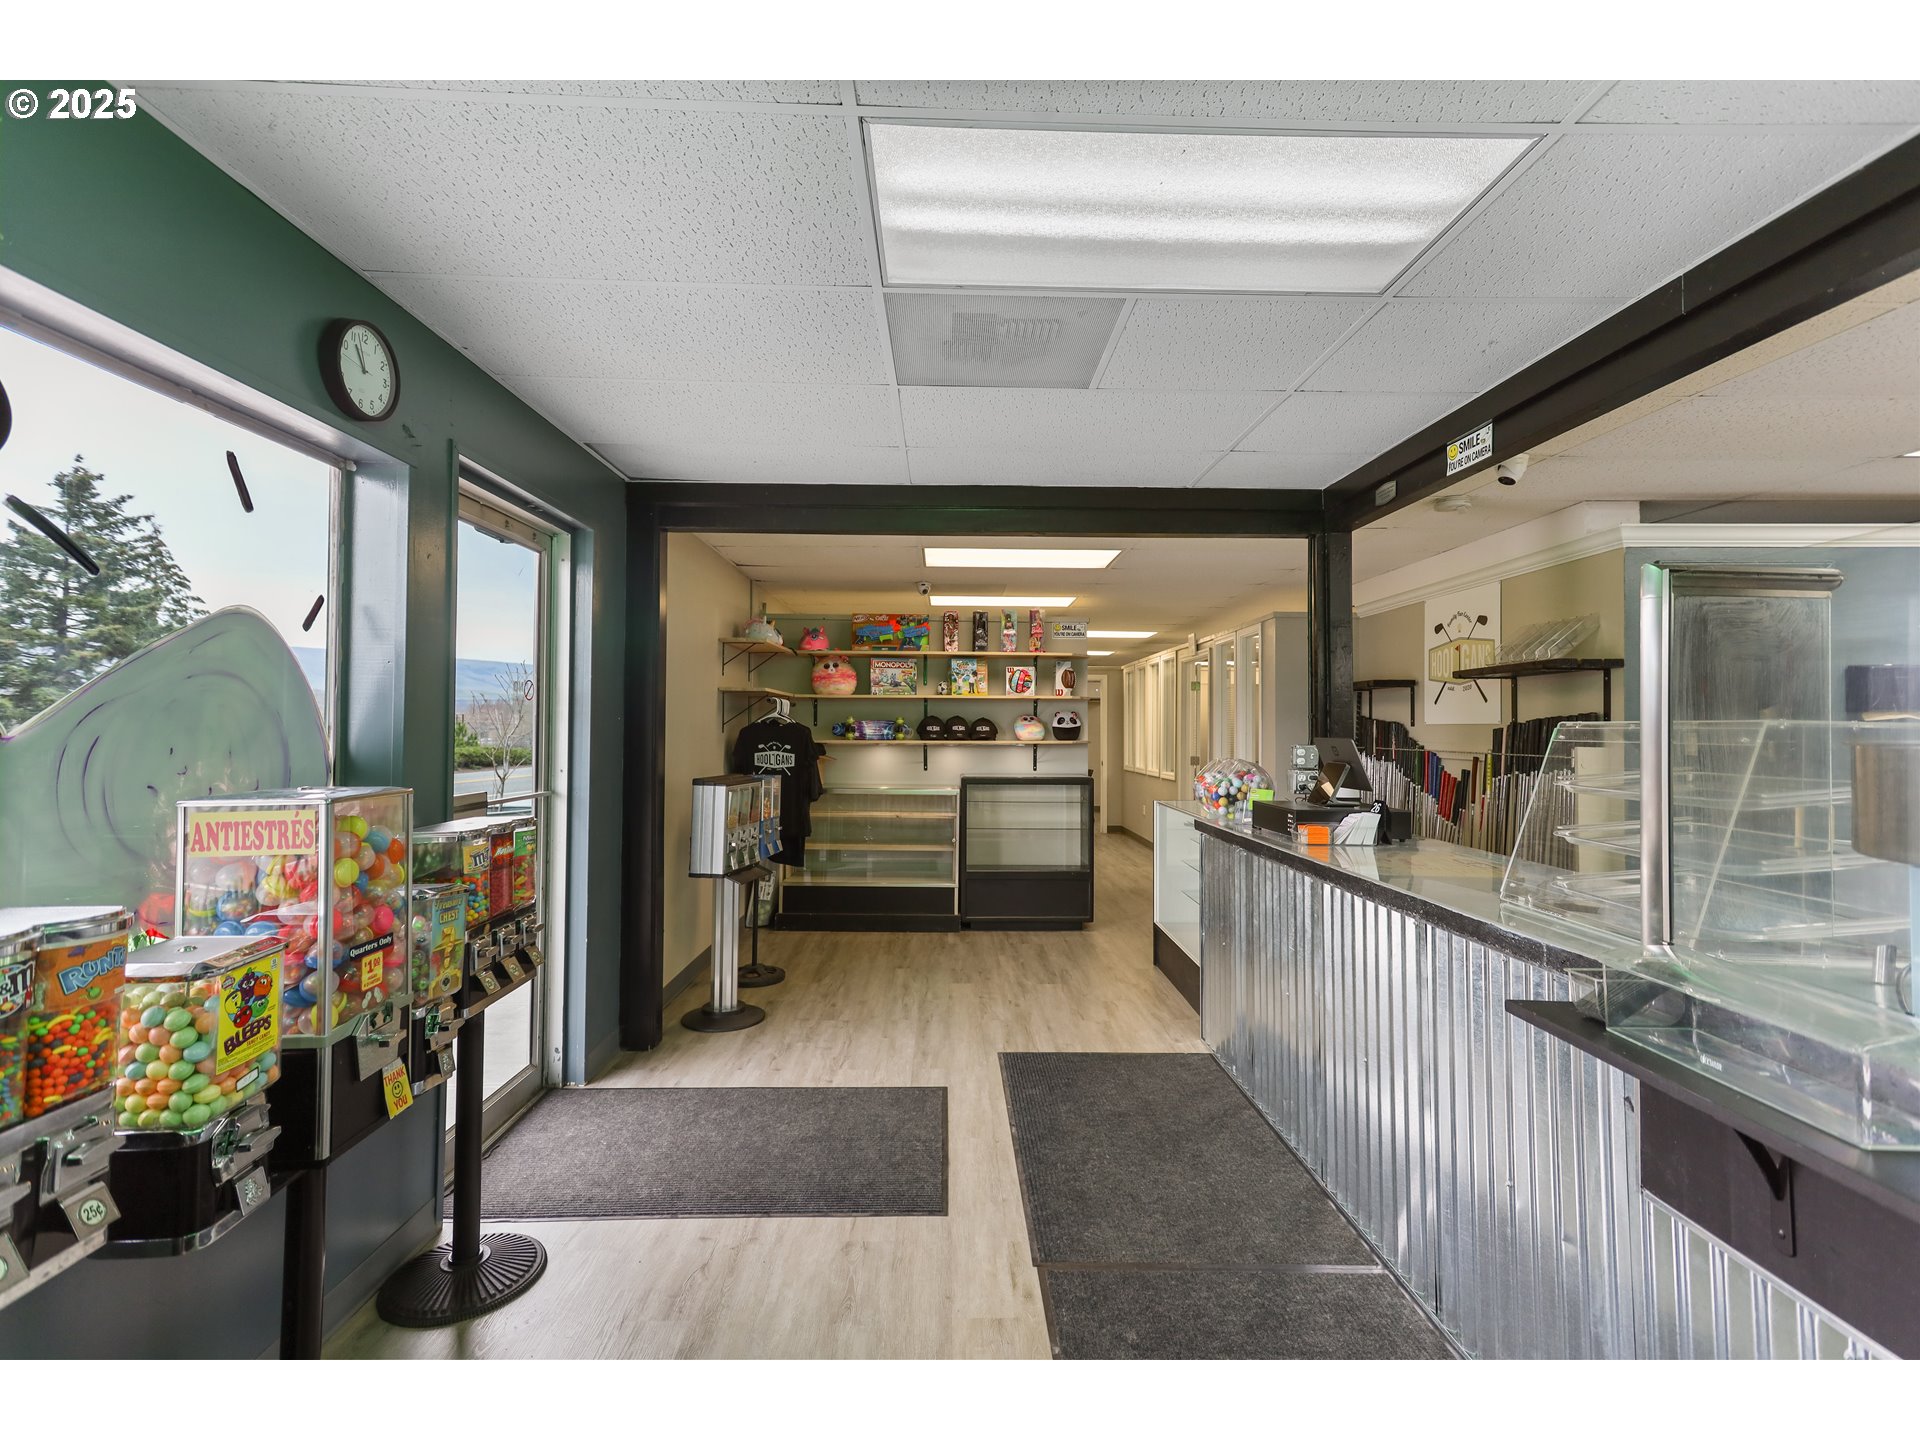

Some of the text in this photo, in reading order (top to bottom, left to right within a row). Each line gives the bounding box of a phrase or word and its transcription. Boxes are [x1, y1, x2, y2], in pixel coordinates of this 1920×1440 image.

[380, 361, 385, 371] 2
[358, 399, 363, 409] 6
[369, 400, 374, 410] 5
[1458, 433, 1480, 454] SMILE
[1448, 443, 1491, 473] YOU'RE ON CAMERA
[1370, 802, 1382, 813] 26
[190, 810, 315, 852] ANTIESTRÉS
[439, 909, 460, 925] CHEST
[350, 936, 393, 958] Quarters Only
[223, 1013, 272, 1056] BLEEPS
[384, 1066, 406, 1087] THANK
[393, 1095, 408, 1110] YOU
[83, 1202, 104, 1221] 25¢
